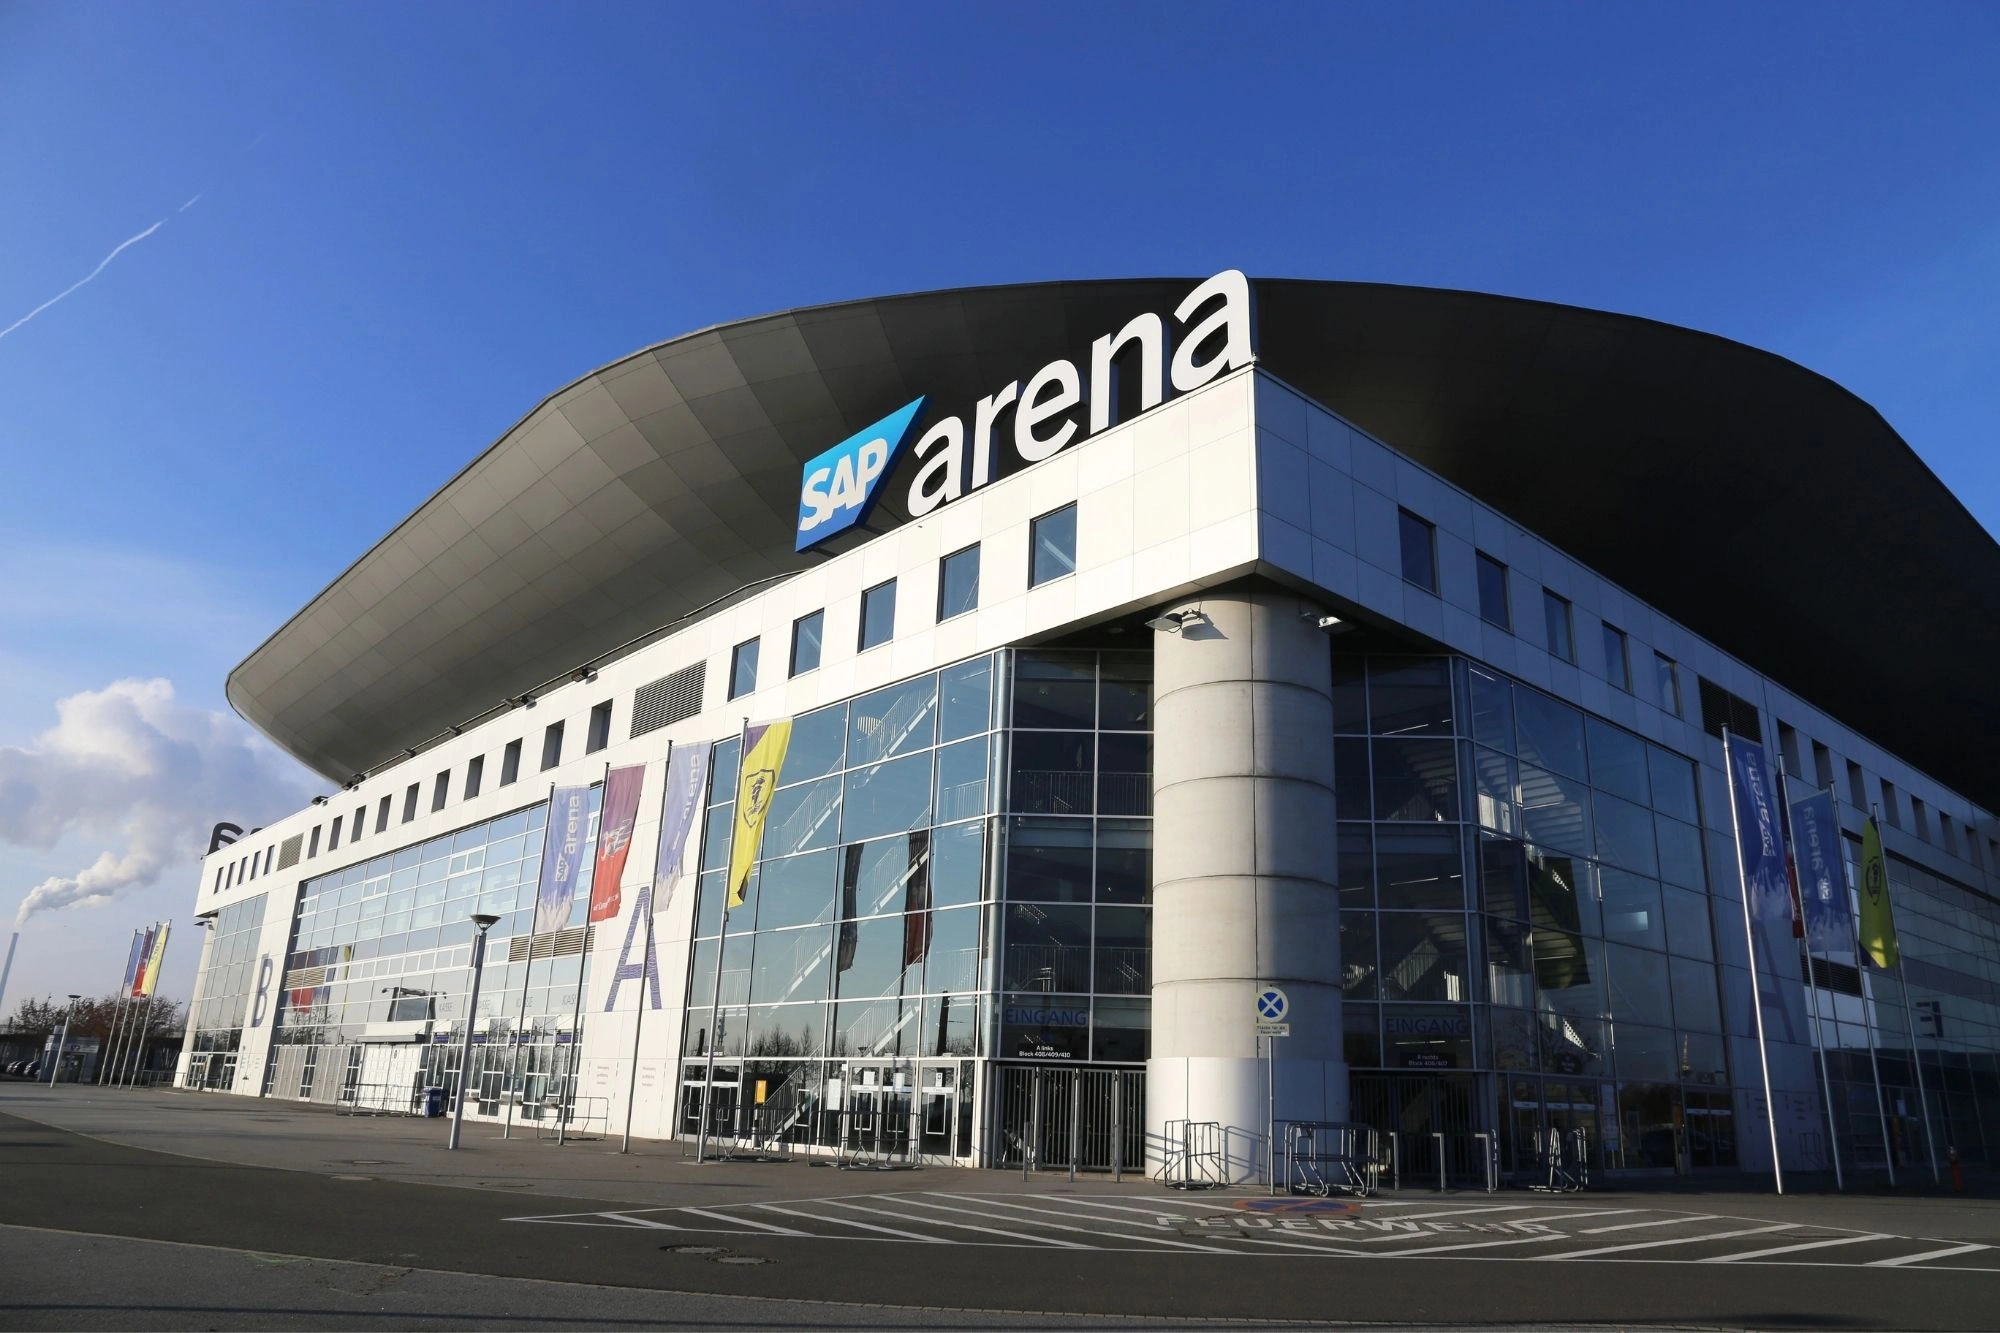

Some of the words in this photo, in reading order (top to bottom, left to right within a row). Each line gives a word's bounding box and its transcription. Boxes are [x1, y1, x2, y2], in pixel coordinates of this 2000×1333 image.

[799, 438, 889, 531] SAP
[907, 268, 1252, 517] arena
[564, 795, 580, 855] arena
[604, 886, 662, 1012] A
[251, 953, 274, 1028] B
[1005, 1009, 1087, 1026] EINGANG
[1386, 1018, 1467, 1034] EINGANG
[1156, 1216, 1563, 1235] FEUERWEHR
